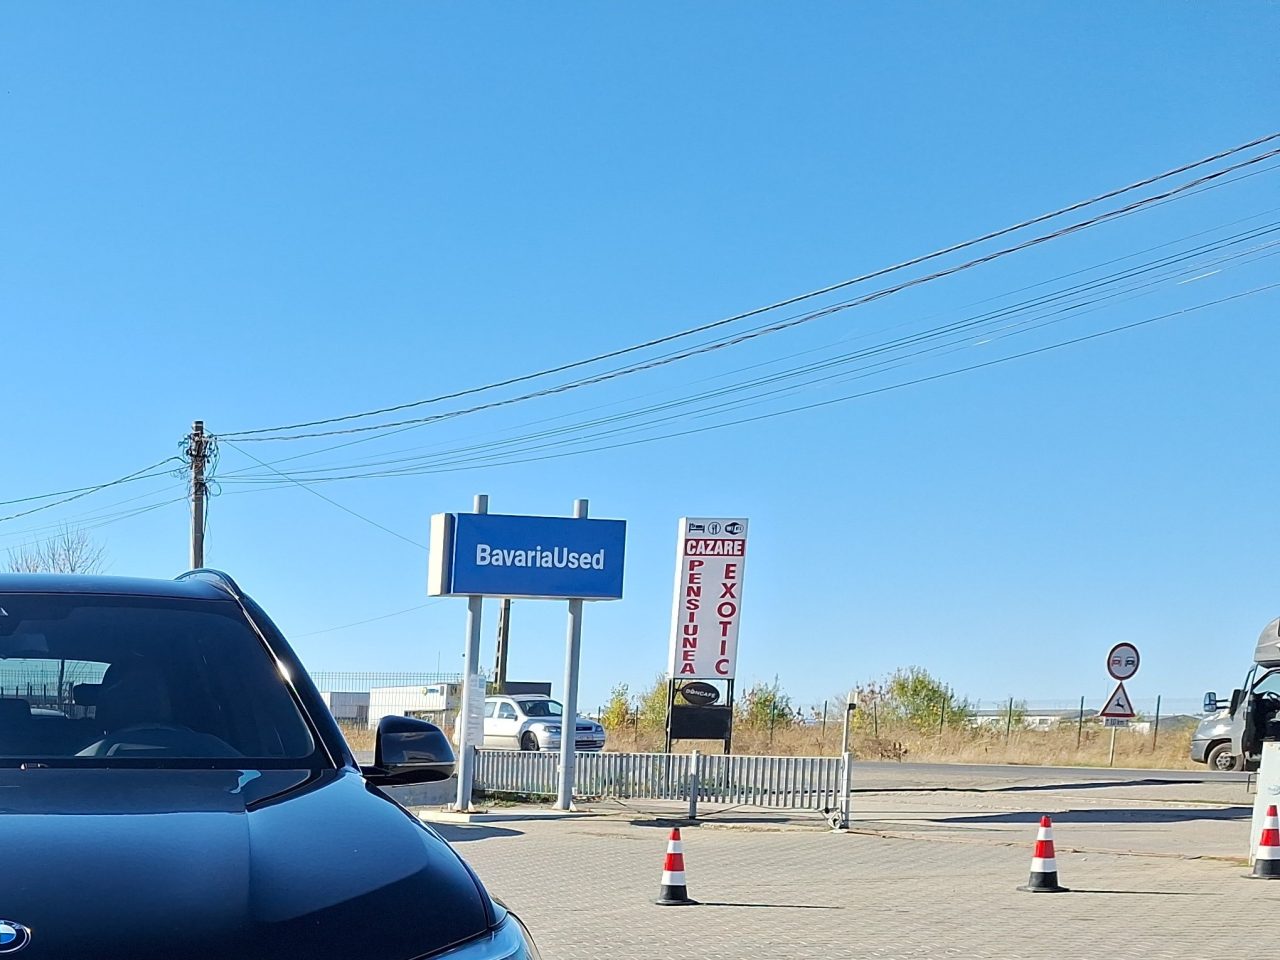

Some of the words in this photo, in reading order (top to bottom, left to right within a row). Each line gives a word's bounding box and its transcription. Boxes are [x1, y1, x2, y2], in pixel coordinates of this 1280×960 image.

[476, 544, 605, 570] BavariaUsed
[686, 540, 742, 555] CAZARE
[680, 559, 705, 674] PENSIUNEA
[714, 563, 738, 675] EXOTIC
